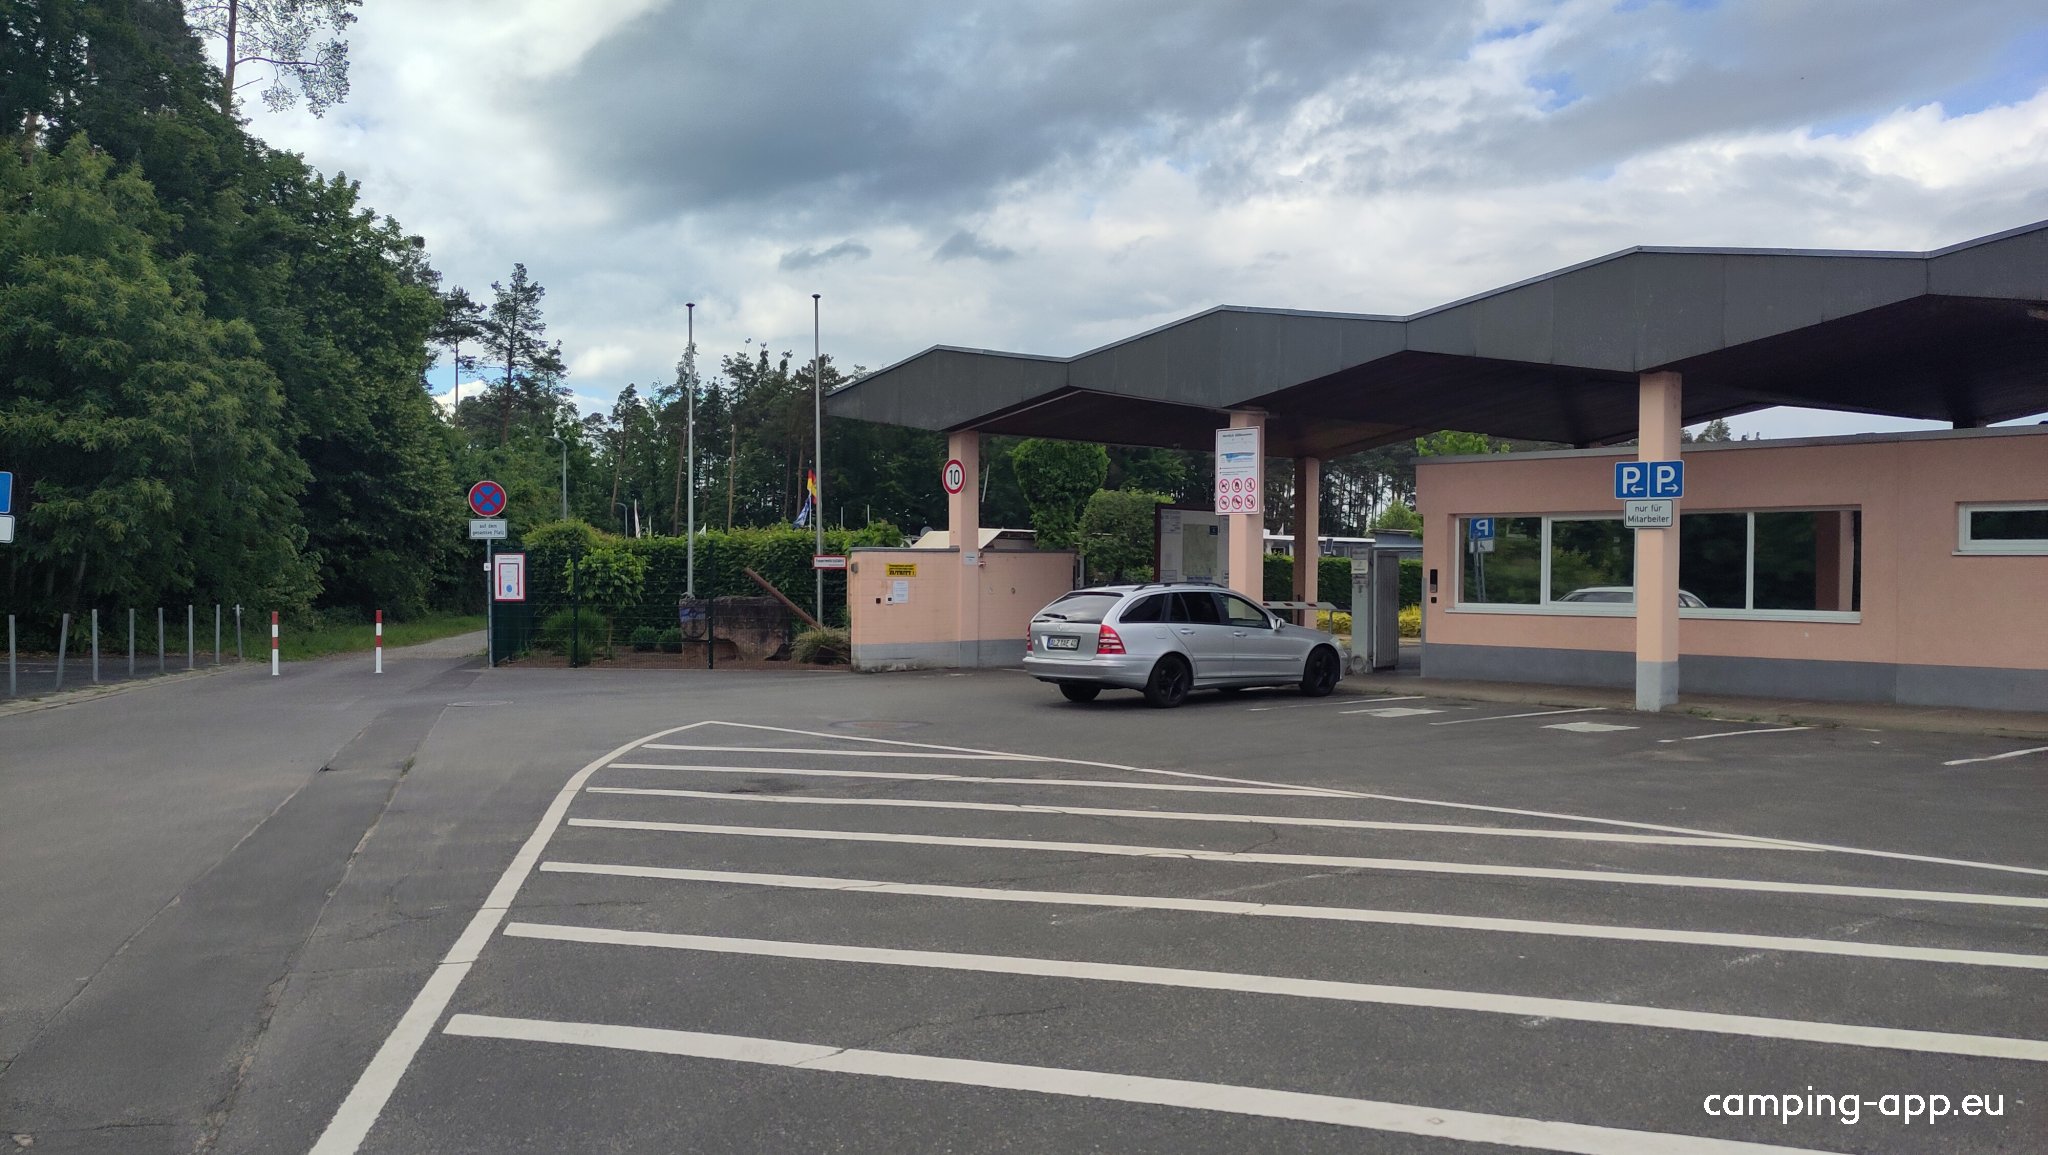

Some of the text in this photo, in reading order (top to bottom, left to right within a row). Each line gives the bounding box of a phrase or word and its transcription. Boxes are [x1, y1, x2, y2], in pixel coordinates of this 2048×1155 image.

[949, 469, 960, 485] 10
[1622, 466, 1641, 494] P
[1656, 465, 1676, 494] P
[1651, 503, 1663, 512] für
[1627, 514, 1670, 523] Mitarbeiter
